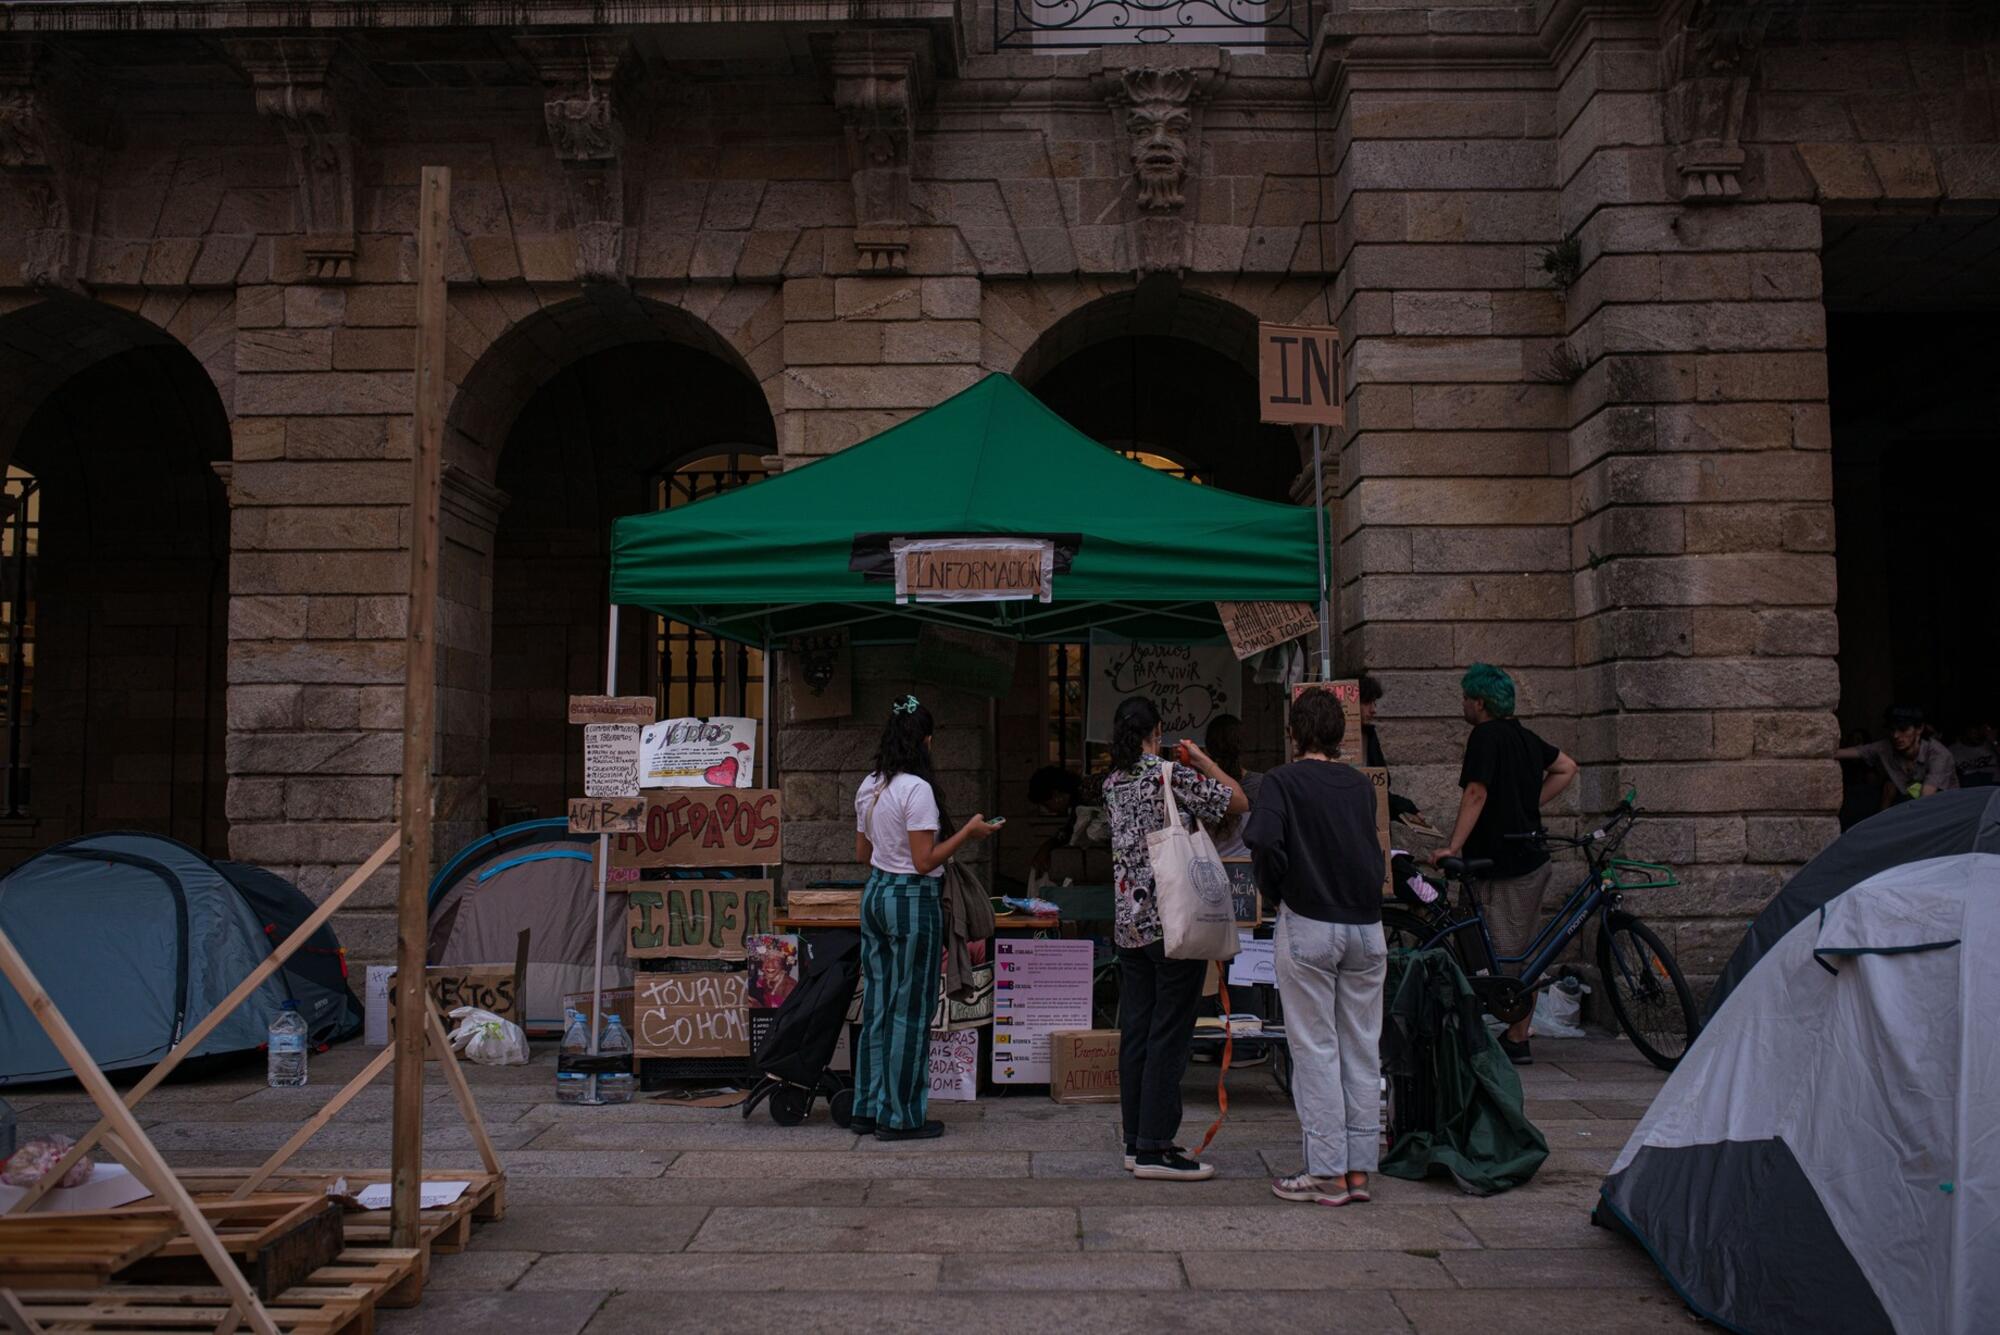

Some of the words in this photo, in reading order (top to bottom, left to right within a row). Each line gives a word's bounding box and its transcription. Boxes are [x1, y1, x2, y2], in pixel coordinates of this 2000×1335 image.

[908, 551, 1042, 589] INFORMACIÓN
[1236, 631, 1275, 656] SOMOS
[1134, 660, 1167, 685] PARA
[1153, 696, 1183, 716] RA
[1232, 883, 1255, 897] NCIA
[641, 1007, 692, 1047] GO
